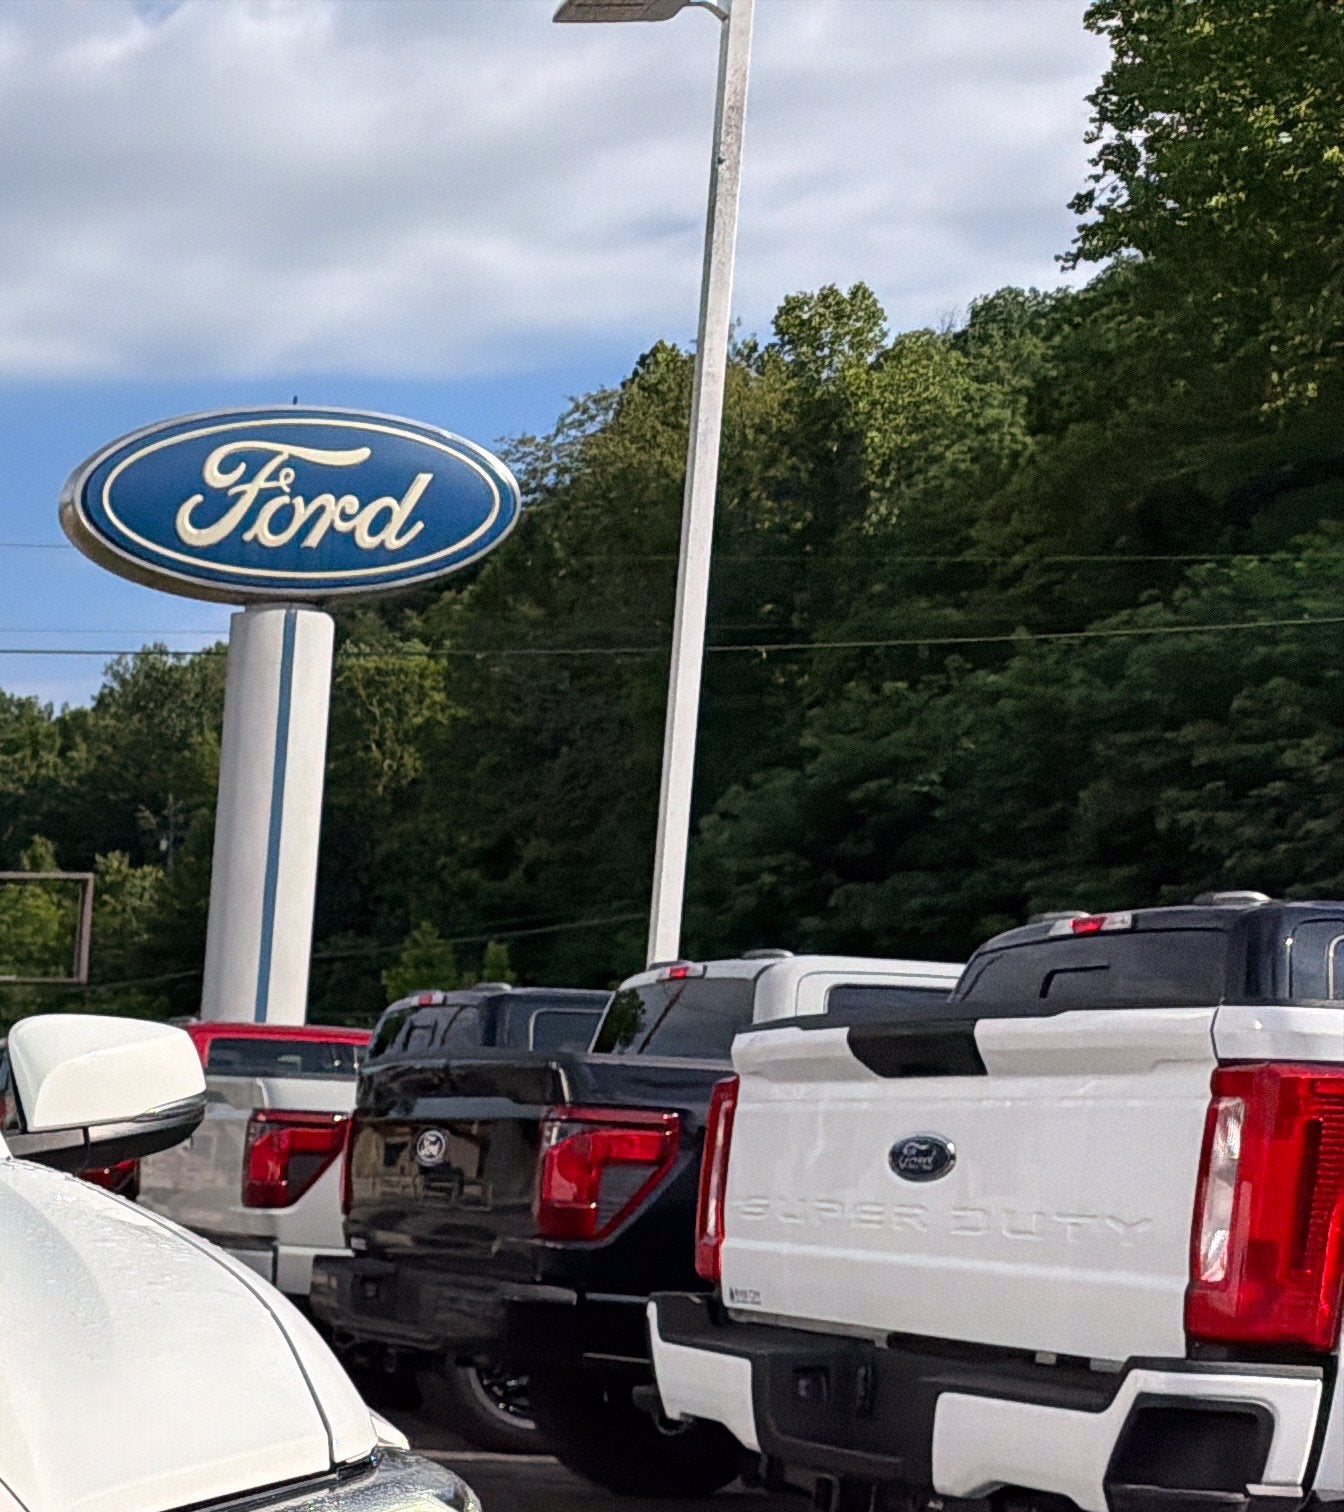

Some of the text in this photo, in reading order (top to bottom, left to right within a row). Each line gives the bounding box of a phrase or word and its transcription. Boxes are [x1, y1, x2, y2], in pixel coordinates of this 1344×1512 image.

[176, 439, 434, 551] Ford
[899, 1141, 937, 1171] Ford
[733, 1196, 1154, 1248] SUPER DUTY
